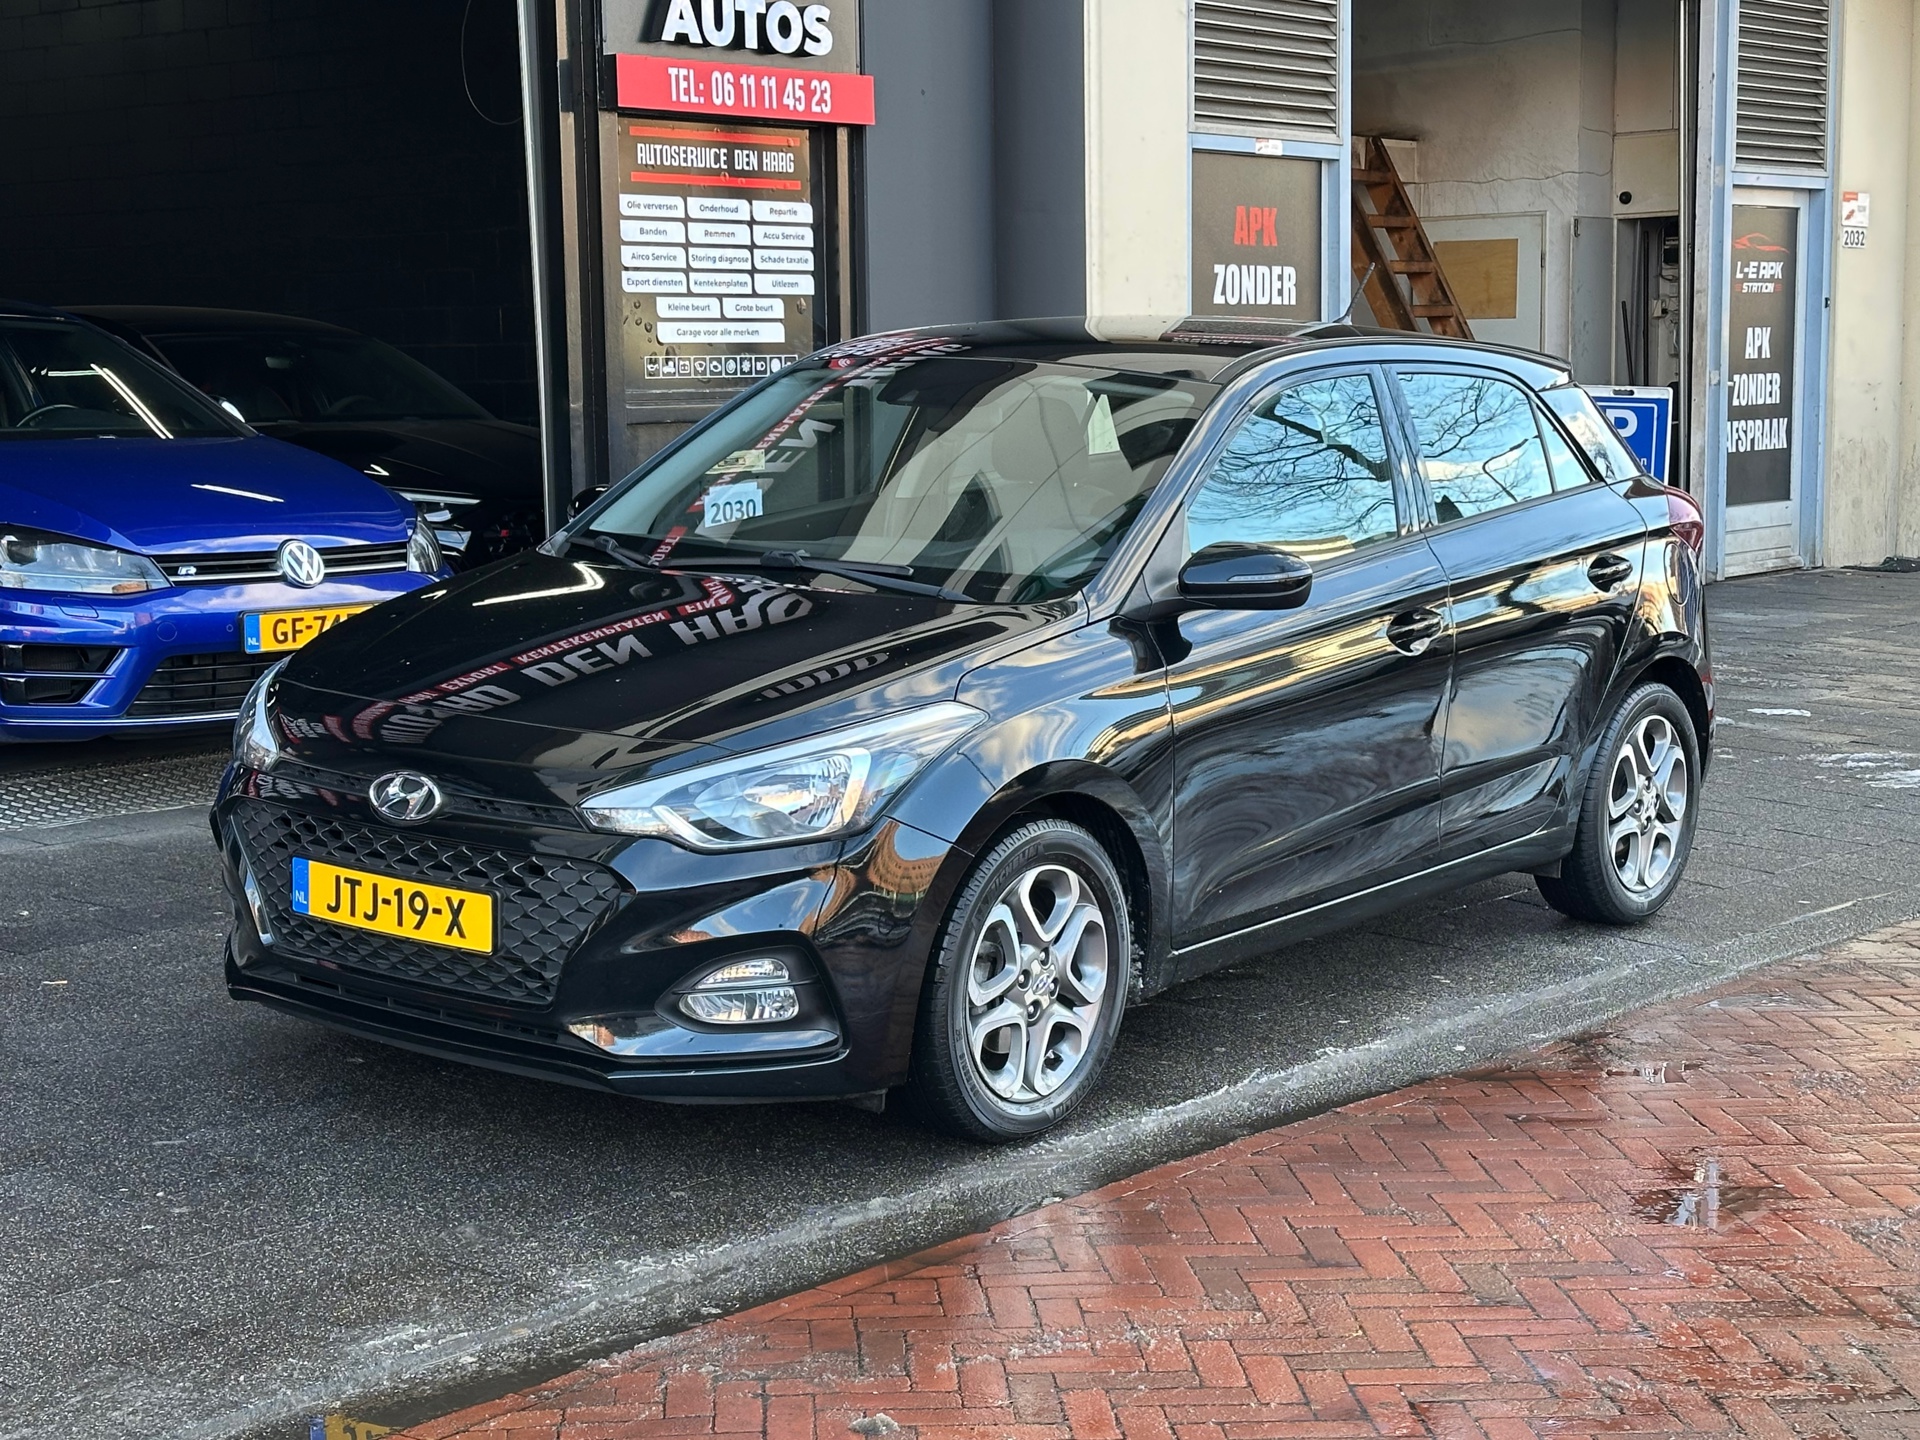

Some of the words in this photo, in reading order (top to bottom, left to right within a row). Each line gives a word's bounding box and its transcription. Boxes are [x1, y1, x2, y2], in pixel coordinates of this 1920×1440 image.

[661, 0, 833, 56] AUTOS
[668, 67, 705, 105] TEL:
[711, 70, 735, 107] 06
[739, 73, 756, 108] 11
[761, 75, 777, 110] 11
[783, 77, 805, 112] 45
[810, 79, 832, 114] 23
[637, 142, 728, 170] AUTOSERVICE
[734, 151, 758, 171] DEN
[763, 152, 795, 173] HAAG
[627, 200, 641, 210] Olie
[643, 203, 678, 212] verversen
[699, 204, 739, 214] Onderhoud
[1233, 205, 1278, 246] APK
[639, 227, 668, 236] Banden
[704, 230, 735, 238] Remmen
[763, 232, 780, 240] Accu
[781, 232, 805, 241] Service
[1844, 230, 1865, 246] 2032
[631, 253, 650, 261] Airco
[651, 254, 677, 262] Service
[691, 254, 716, 265] Storing
[718, 255, 749, 265] diagnose
[760, 255, 785, 264] Schade
[786, 256, 809, 264] taxatie
[1759, 261, 1784, 279] APK
[626, 277, 650, 288] Export
[652, 277, 683, 287] diensten
[694, 279, 749, 289] Kentekenplaten
[772, 280, 799, 288] Uitlezen
[1213, 264, 1297, 305] ZONDER
[1741, 282, 1775, 293] STATION
[667, 303, 690, 312] Kleine
[691, 303, 711, 312] beurt
[735, 304, 754, 313] Grote
[755, 304, 774, 312] beurt
[676, 328, 701, 338] Garage
[720, 328, 732, 336] alle
[733, 328, 760, 336] merken
[1745, 327, 1772, 359] APK
[1732, 372, 1781, 406] ZONDER
[1606, 409, 1638, 438] P
[1726, 418, 1788, 453] AFSPRAAK
[710, 499, 757, 524] 2030
[247, 637, 259, 646] NL
[294, 889, 308, 905] NL
[327, 874, 467, 940] JTJ-19-X
